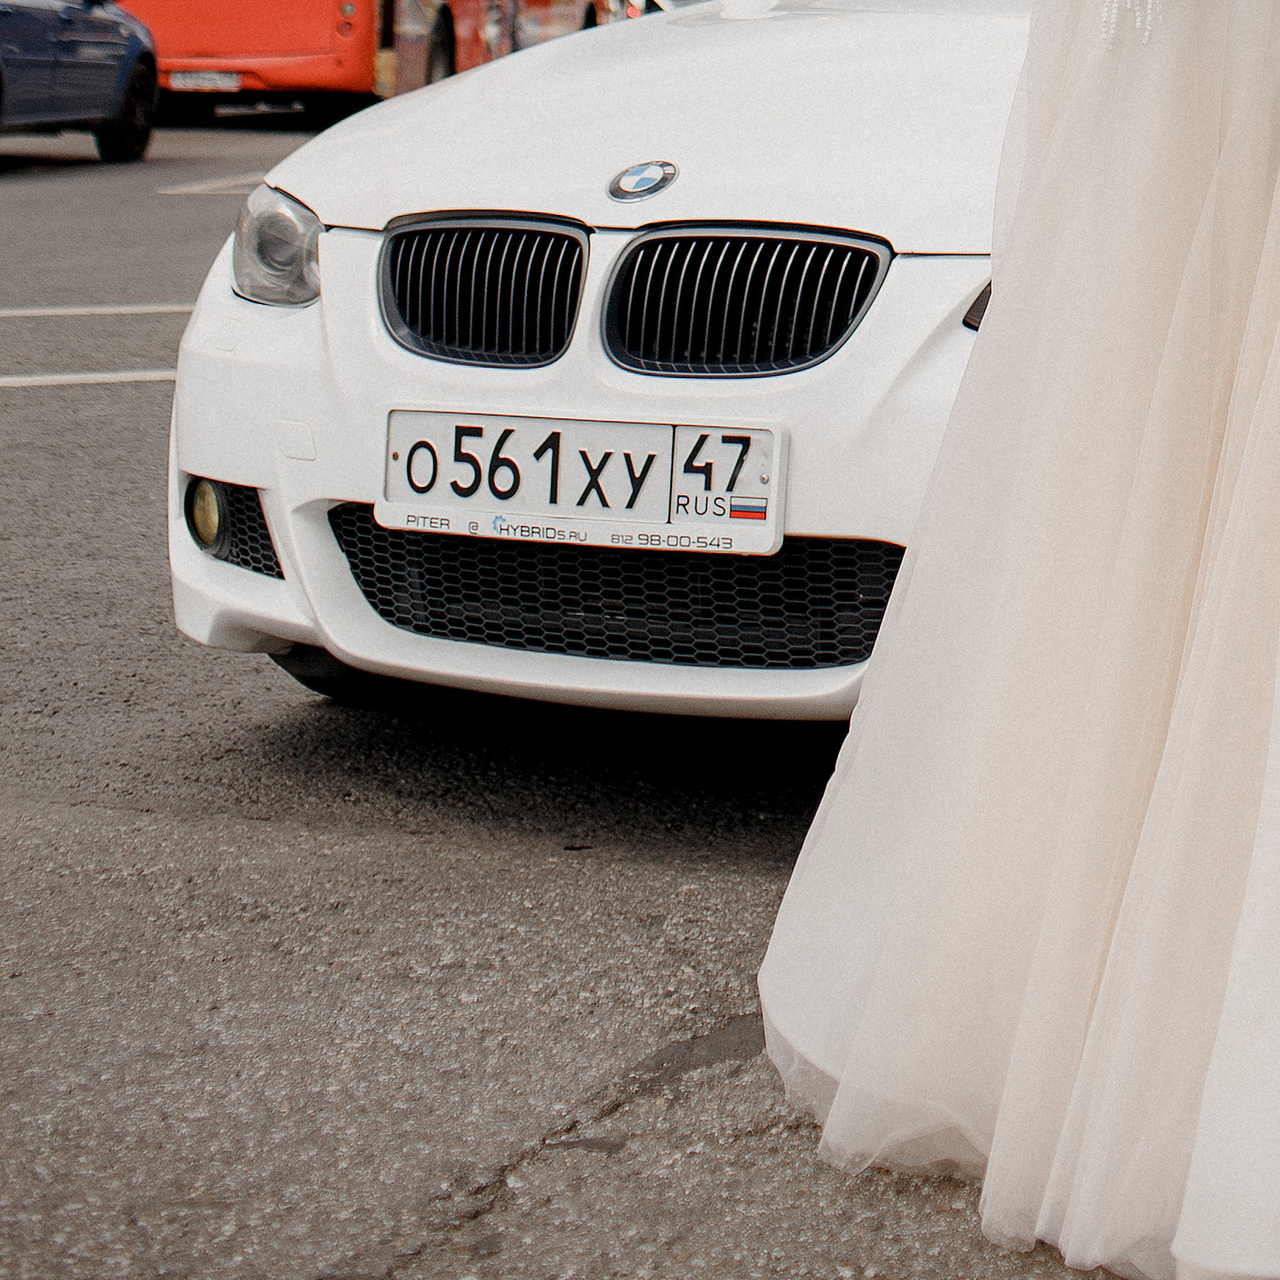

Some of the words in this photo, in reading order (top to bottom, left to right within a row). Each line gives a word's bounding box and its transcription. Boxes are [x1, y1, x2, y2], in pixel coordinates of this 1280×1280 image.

[682, 433, 752, 492] 47
[676, 494, 726, 517] RUS
[406, 514, 451, 530] PITER
[611, 533, 633, 545] 812
[637, 533, 733, 550] 98-00-543
